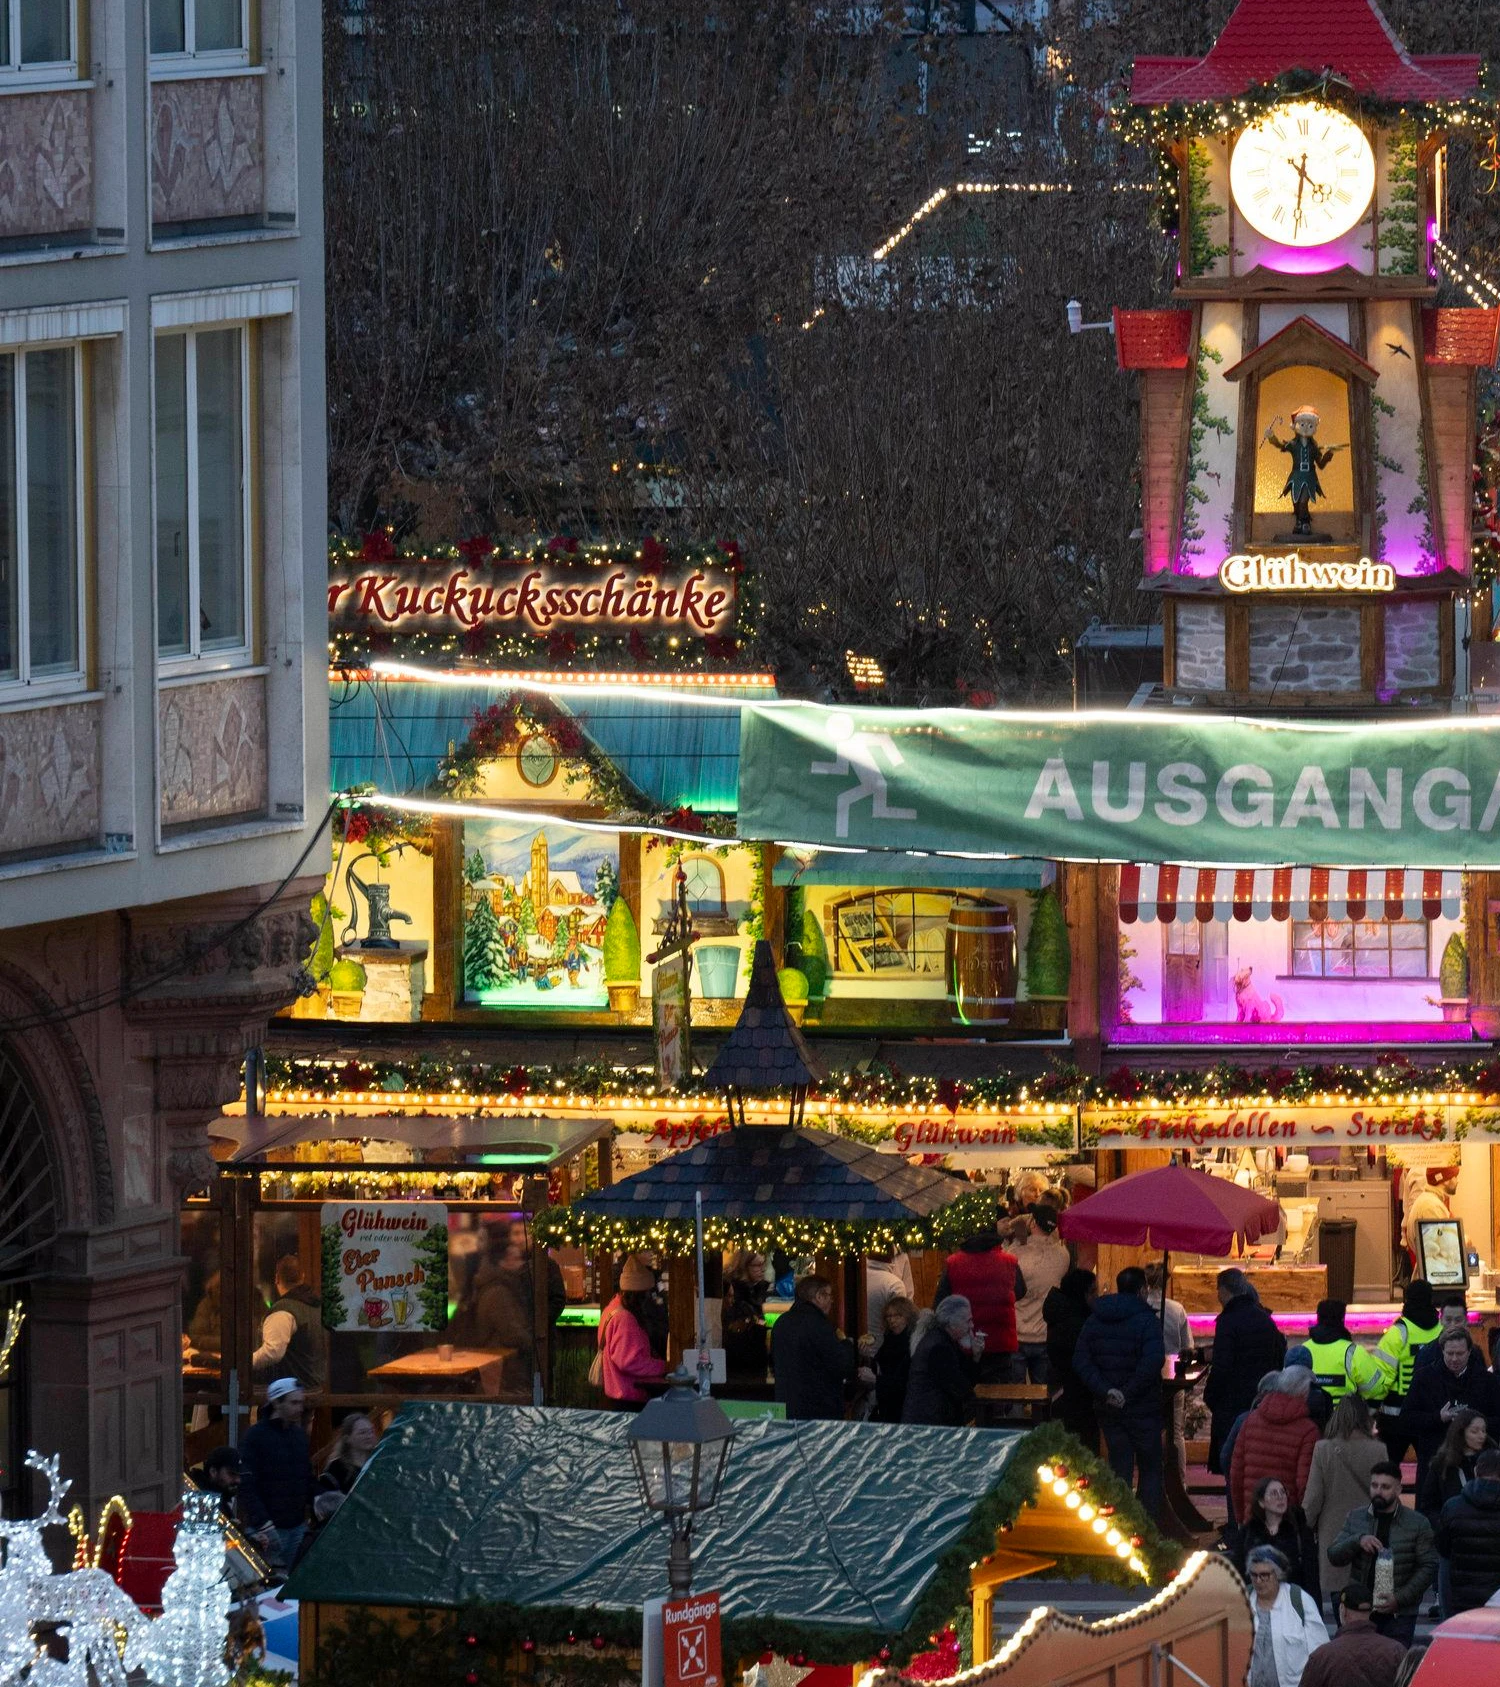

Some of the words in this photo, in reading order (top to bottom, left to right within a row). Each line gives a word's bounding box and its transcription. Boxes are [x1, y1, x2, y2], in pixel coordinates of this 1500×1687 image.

[1222, 555, 1394, 590] Glühwein
[328, 582, 349, 613] r
[355, 571, 726, 628] Kuckucksschänke
[895, 1119, 1017, 1152] Glühwein
[1139, 1111, 1297, 1145] Frikadellen
[1347, 1111, 1443, 1142] Steaks
[341, 1207, 429, 1238] Glühwein
[360, 1233, 373, 1241] rot
[374, 1233, 392, 1242] oder
[342, 1248, 381, 1276] Eier
[356, 1262, 426, 1293] Punsch
[665, 1601, 717, 1625] Rundgänge
